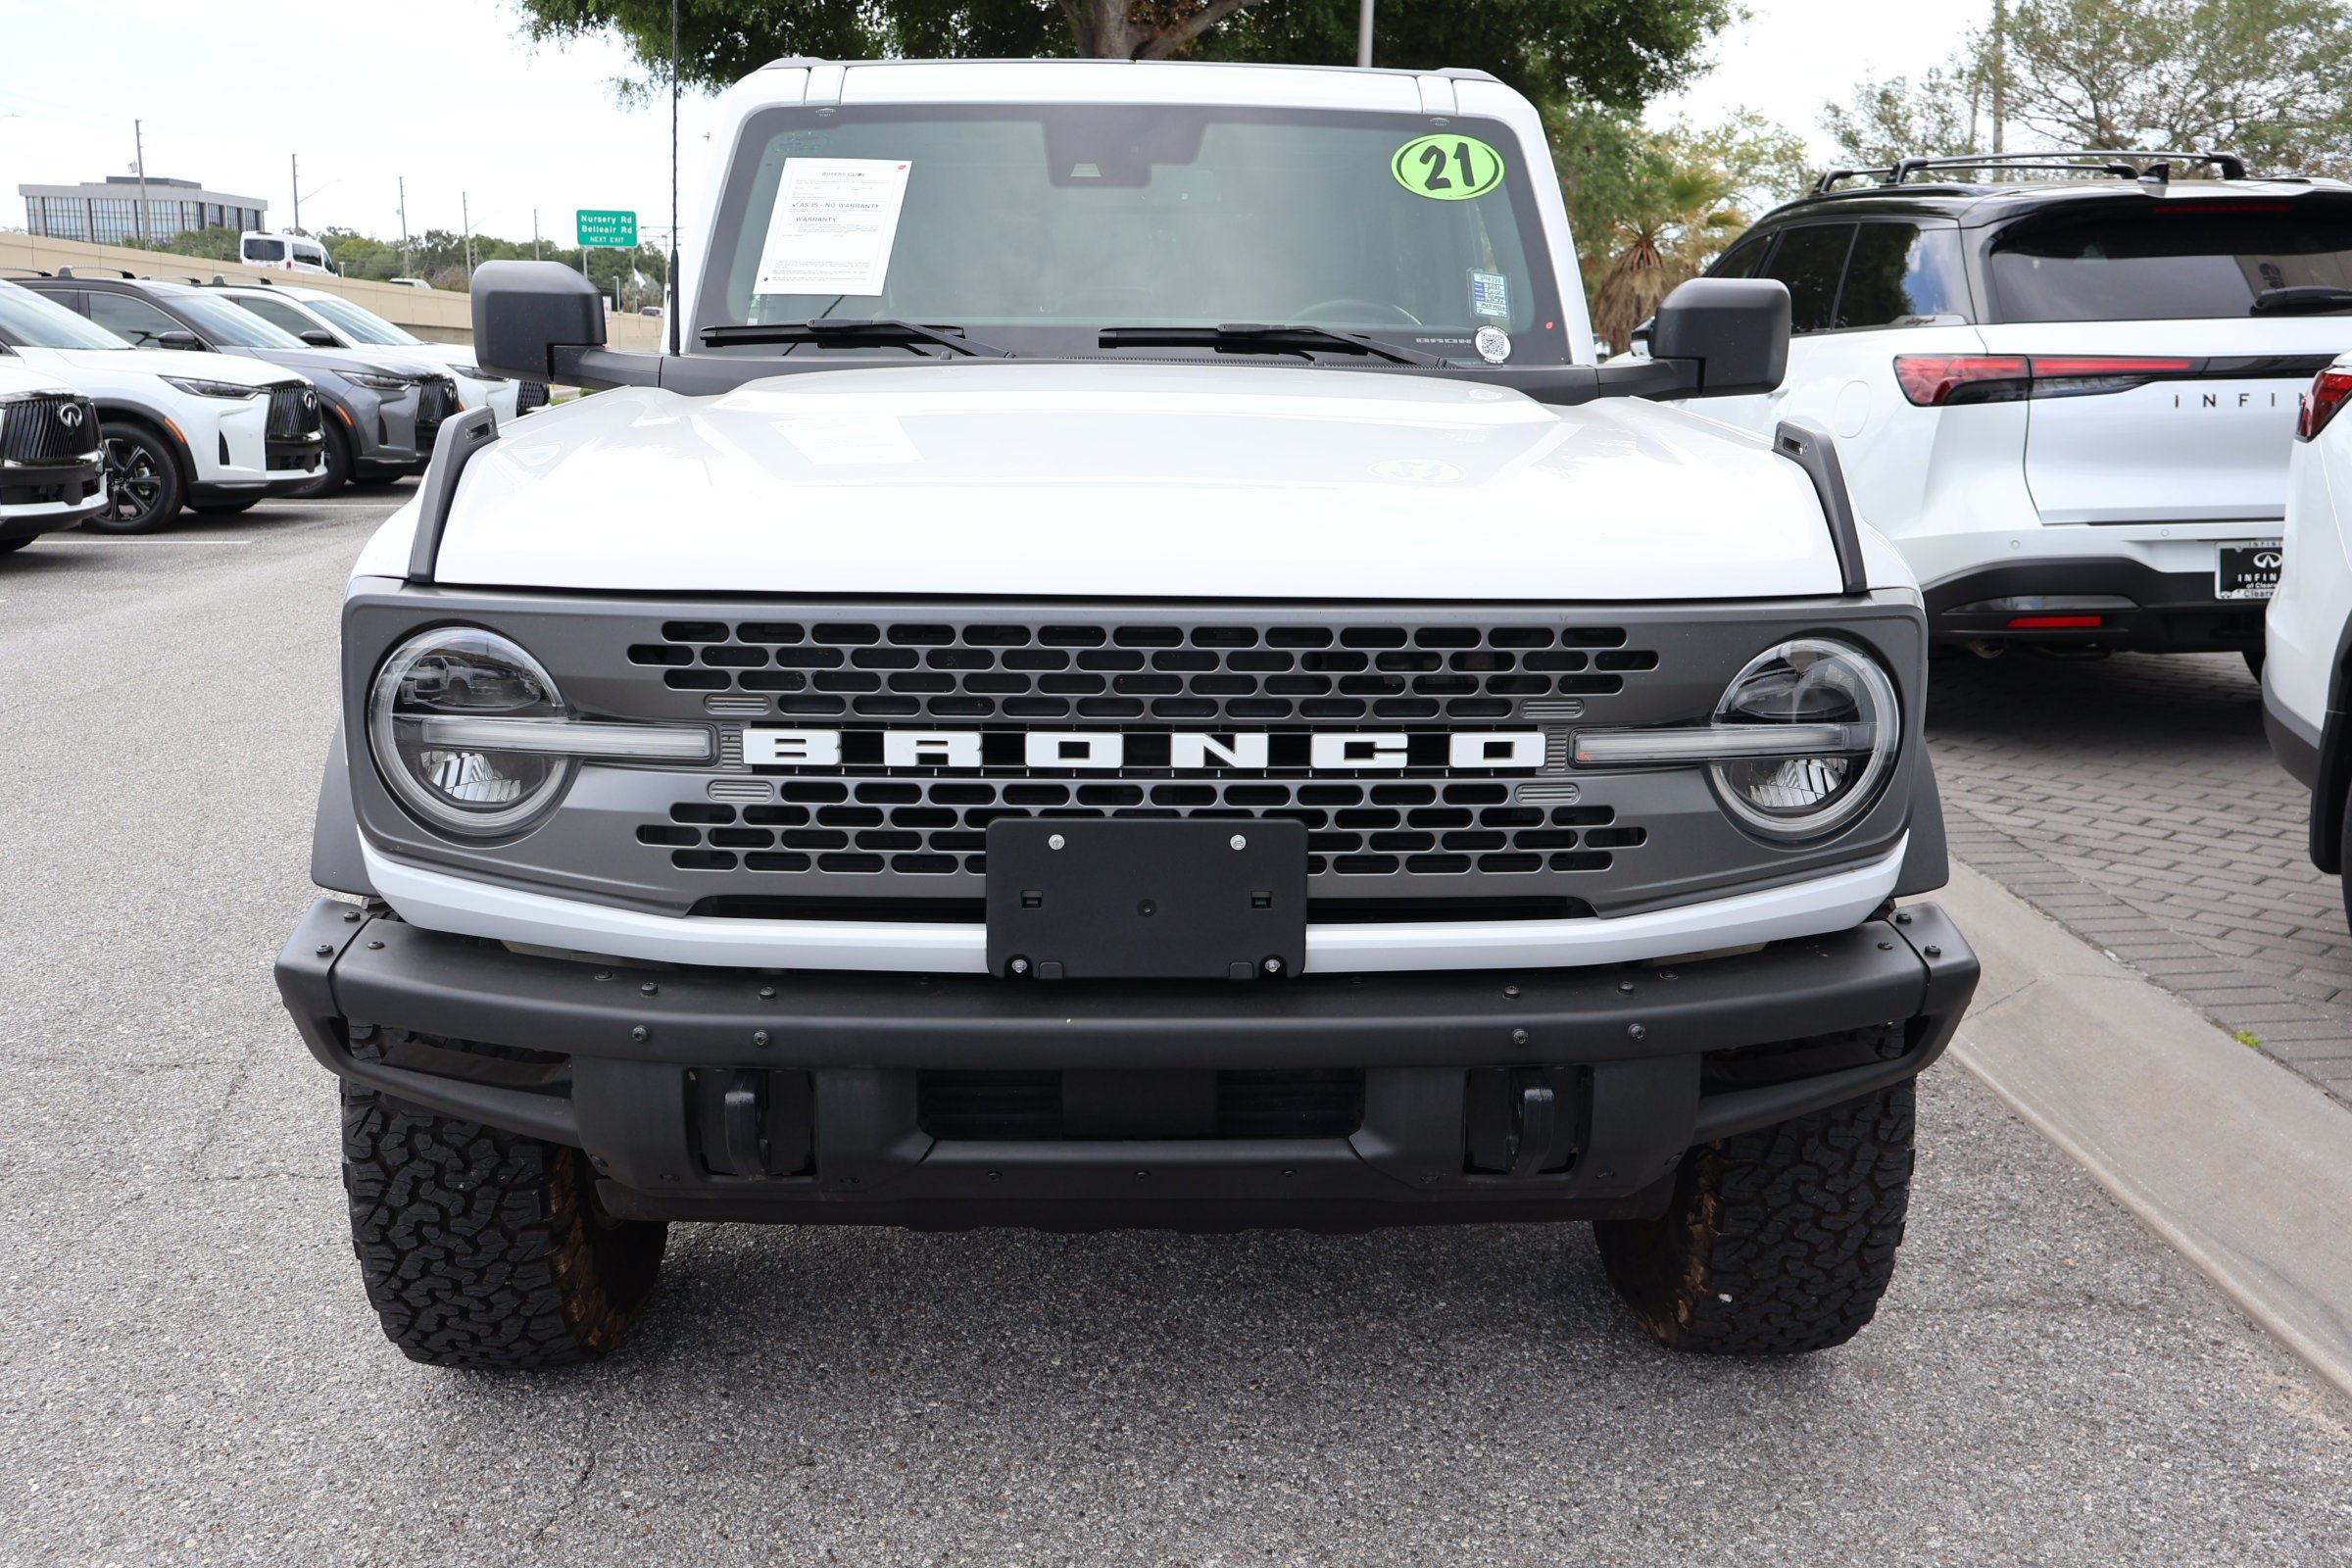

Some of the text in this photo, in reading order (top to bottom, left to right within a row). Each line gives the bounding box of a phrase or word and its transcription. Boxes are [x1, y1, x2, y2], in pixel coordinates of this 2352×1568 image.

[1419, 142, 1475, 190] 21
[581, 215, 616, 224] Nursery
[581, 224, 632, 234] Belleair Rd
[742, 729, 1546, 769] BRONCO
